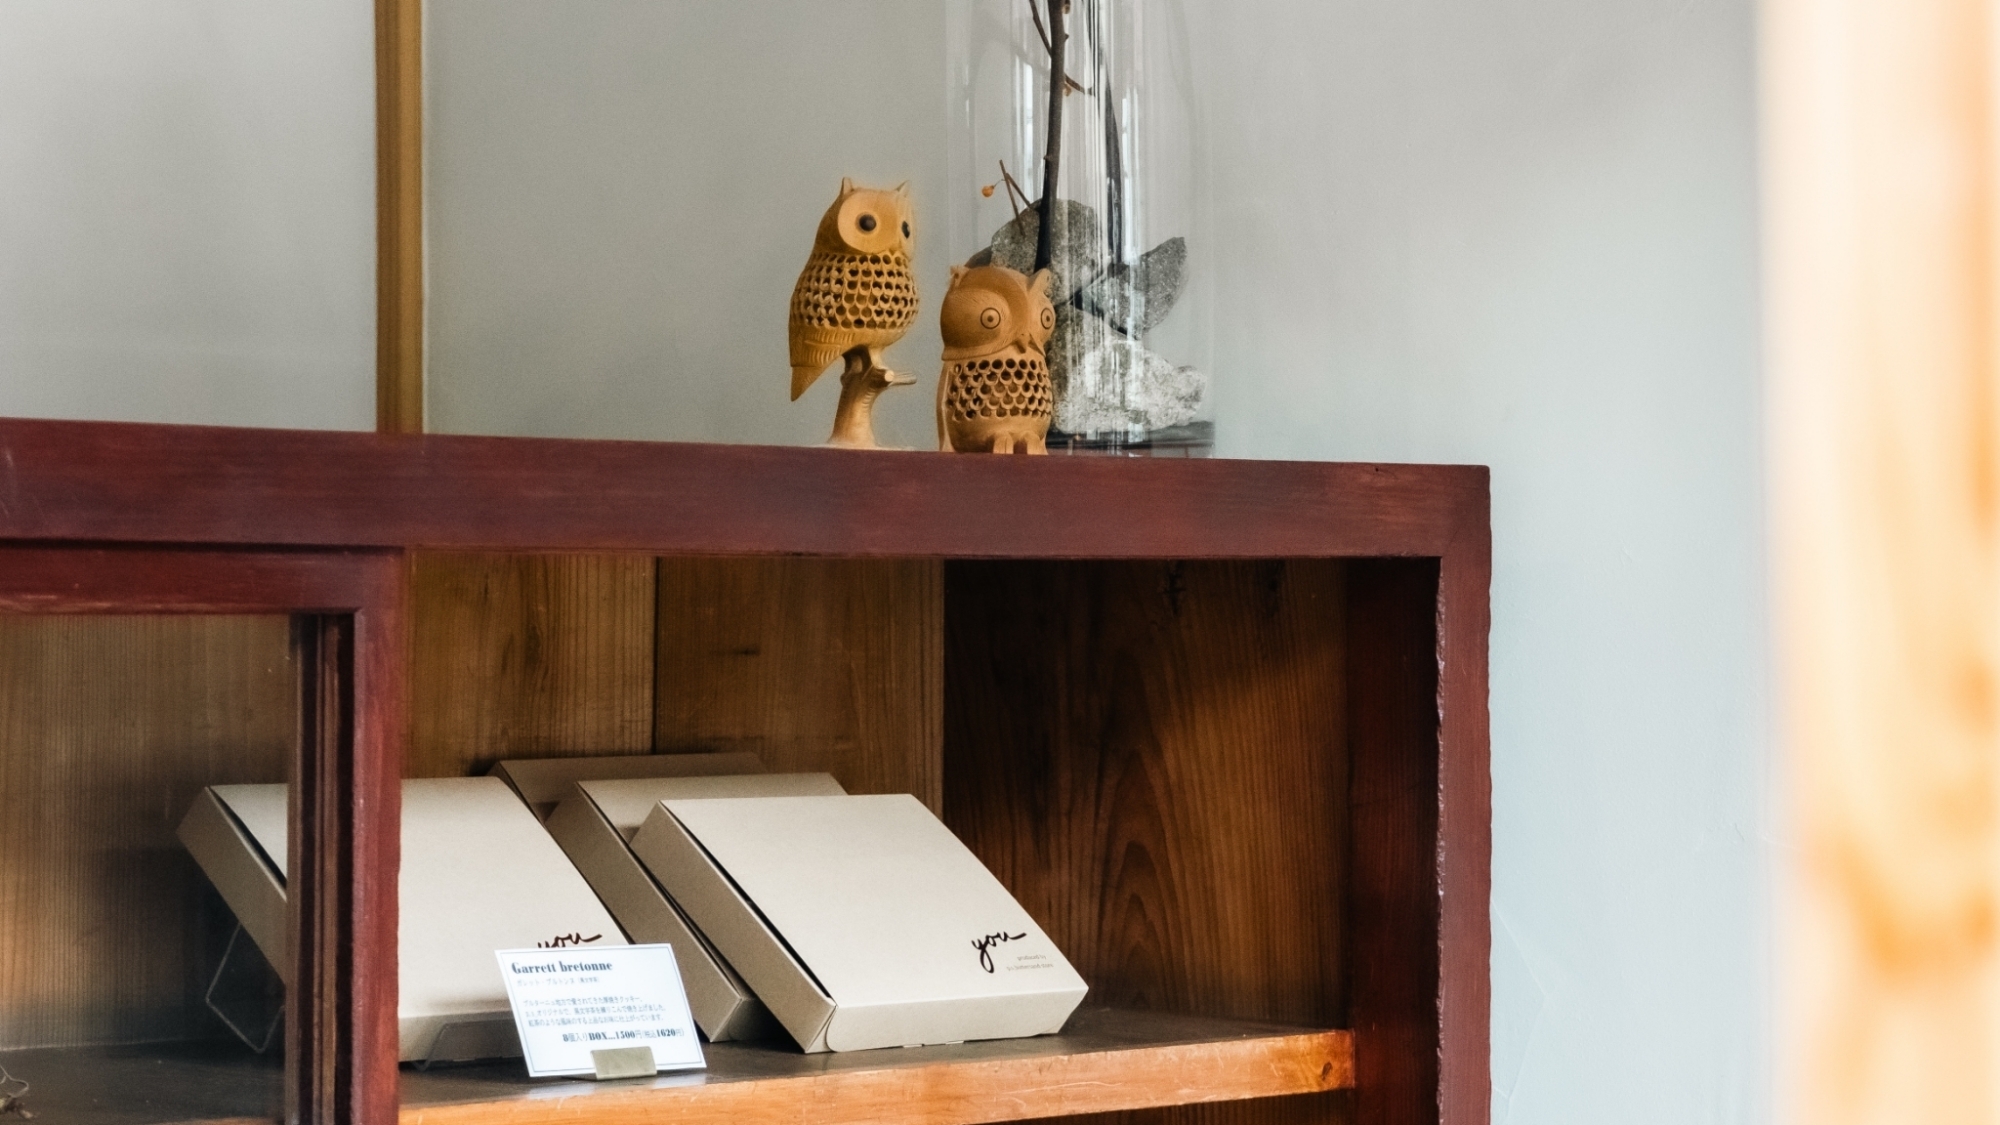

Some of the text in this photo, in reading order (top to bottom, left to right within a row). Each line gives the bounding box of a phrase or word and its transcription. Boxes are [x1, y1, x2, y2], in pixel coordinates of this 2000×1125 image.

[537, 932, 602, 948] ou
[971, 931, 1027, 974] you
[511, 960, 613, 974] Garrett bretonne
